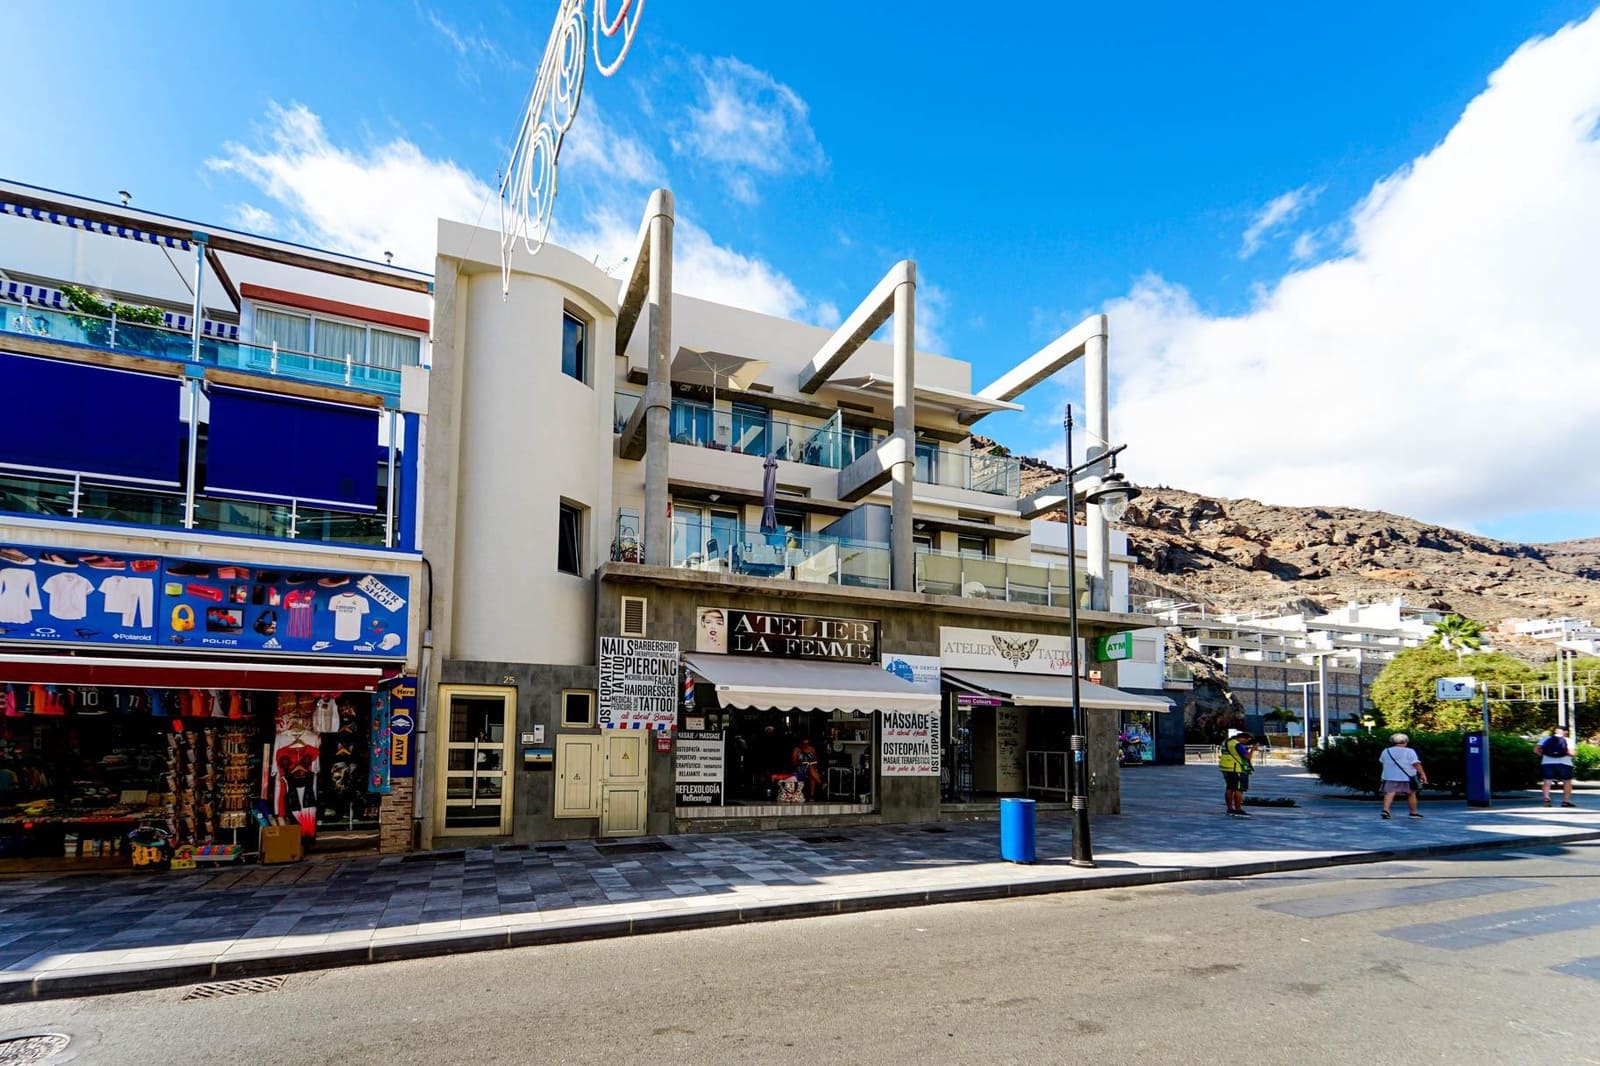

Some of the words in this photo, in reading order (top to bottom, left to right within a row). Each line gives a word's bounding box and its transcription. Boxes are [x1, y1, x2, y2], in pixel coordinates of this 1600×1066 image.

[363, 584, 393, 606] SHOP
[368, 578, 400, 603] SUPER
[734, 614, 870, 642] ATELIER
[602, 638, 634, 656] NAILS
[634, 640, 677, 652] BARBERSHOP
[735, 634, 773, 653] LA
[786, 638, 871, 659] FEMME
[944, 642, 998, 656] ATELIER
[1107, 641, 1126, 651] ATM
[612, 656, 624, 694] TATTOO
[625, 657, 677, 676] PIERCING
[503, 676, 516, 684] 25
[600, 654, 612, 724] OSTEOPATHY
[654, 676, 676, 686] FACIAL
[80, 692, 98, 706] 10
[624, 684, 676, 697] HAIRDRESSER
[639, 697, 672, 712] TATTOO
[884, 712, 930, 730] MASSAGE
[395, 739, 404, 760] ATM
[883, 740, 930, 756] OSTEOPATÍA
[931, 716, 939, 772] OSTEOPATHY
[675, 783, 720, 794] REFLEXOLOGÍA
[683, 794, 712, 804] Reflexology
